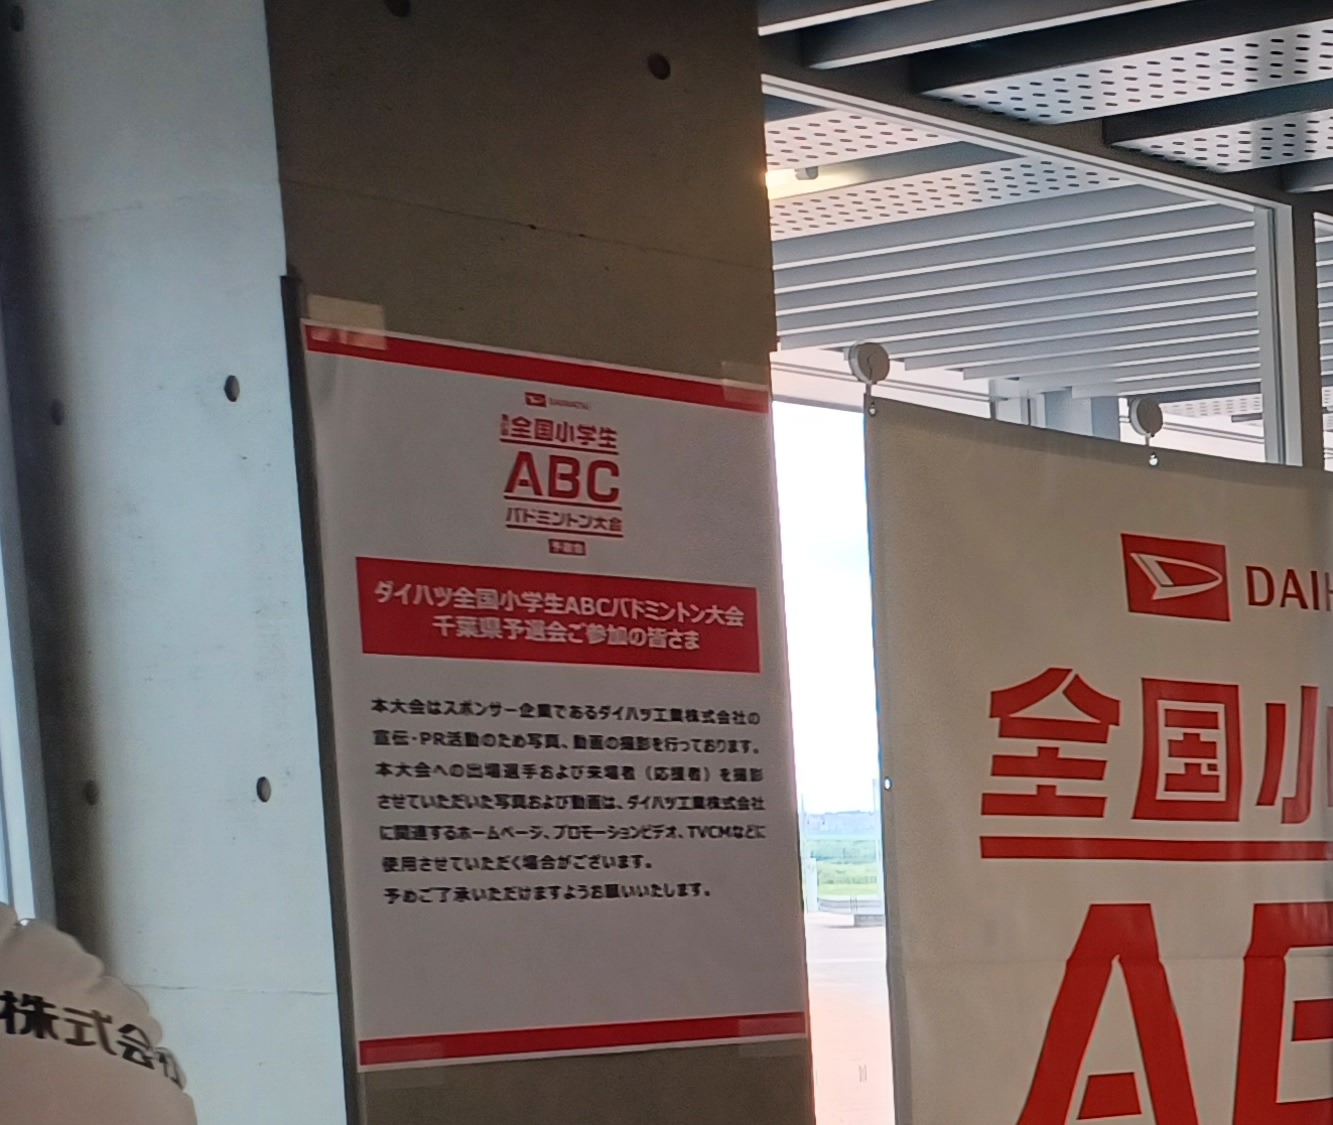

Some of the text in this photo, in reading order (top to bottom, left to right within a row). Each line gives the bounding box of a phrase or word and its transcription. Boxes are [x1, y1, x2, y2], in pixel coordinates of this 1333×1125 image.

[511, 416, 618, 449] 全国小学生
[504, 451, 620, 504] ABC
[505, 507, 623, 532] バドミントン大会
[374, 580, 745, 627] ダイハツ全国小学生ABCバドミントン大会
[432, 615, 700, 651] 千葉県予選会ご参加の皆さま
